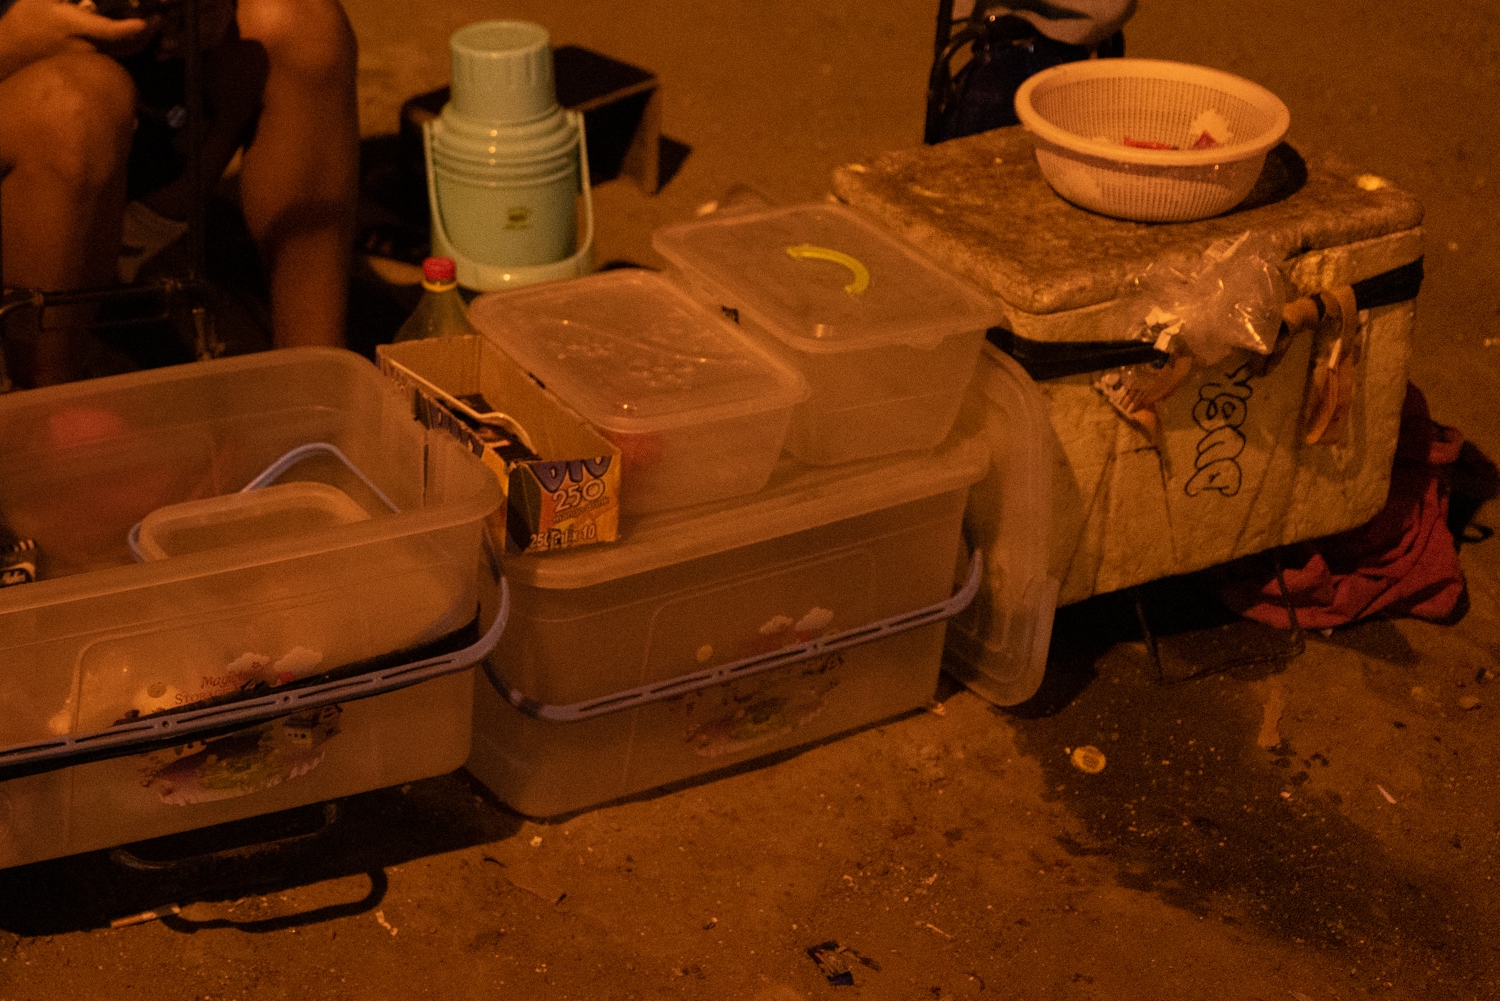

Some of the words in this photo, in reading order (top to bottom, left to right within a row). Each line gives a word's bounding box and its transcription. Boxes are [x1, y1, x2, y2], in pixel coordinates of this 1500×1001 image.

[553, 480, 606, 513] 250
[554, 508, 585, 523] mango
[586, 496, 610, 510] drink
[583, 524, 597, 540] 10
